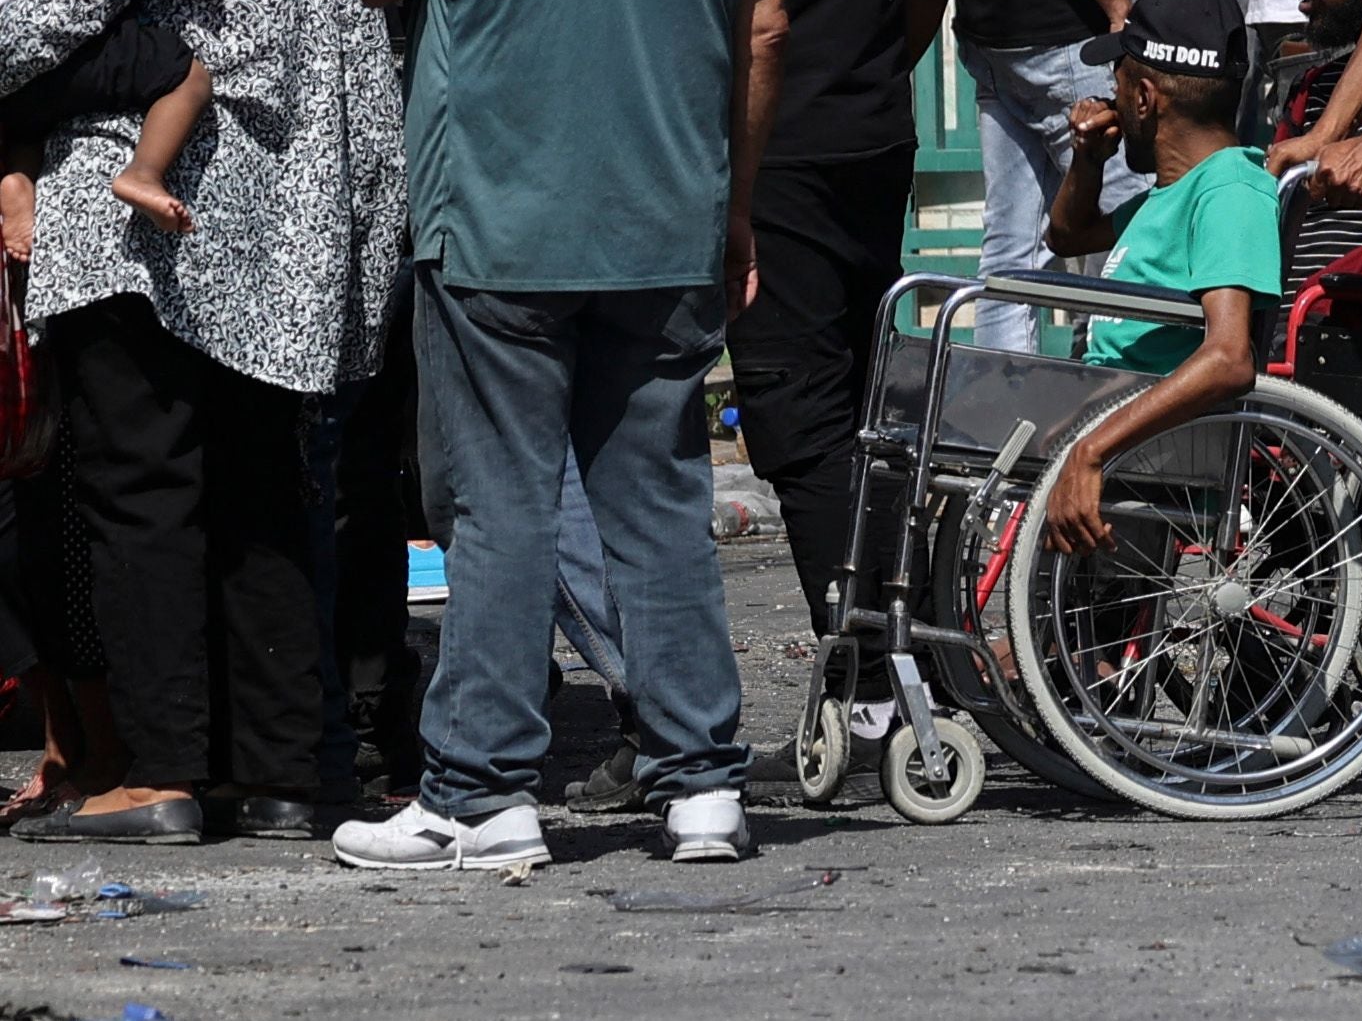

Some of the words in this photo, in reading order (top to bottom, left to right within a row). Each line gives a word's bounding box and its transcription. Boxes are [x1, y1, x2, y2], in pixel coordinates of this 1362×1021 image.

[1142, 40, 1175, 62] JUST
[1175, 46, 1201, 65] DO
[1200, 49, 1220, 68] IT.
